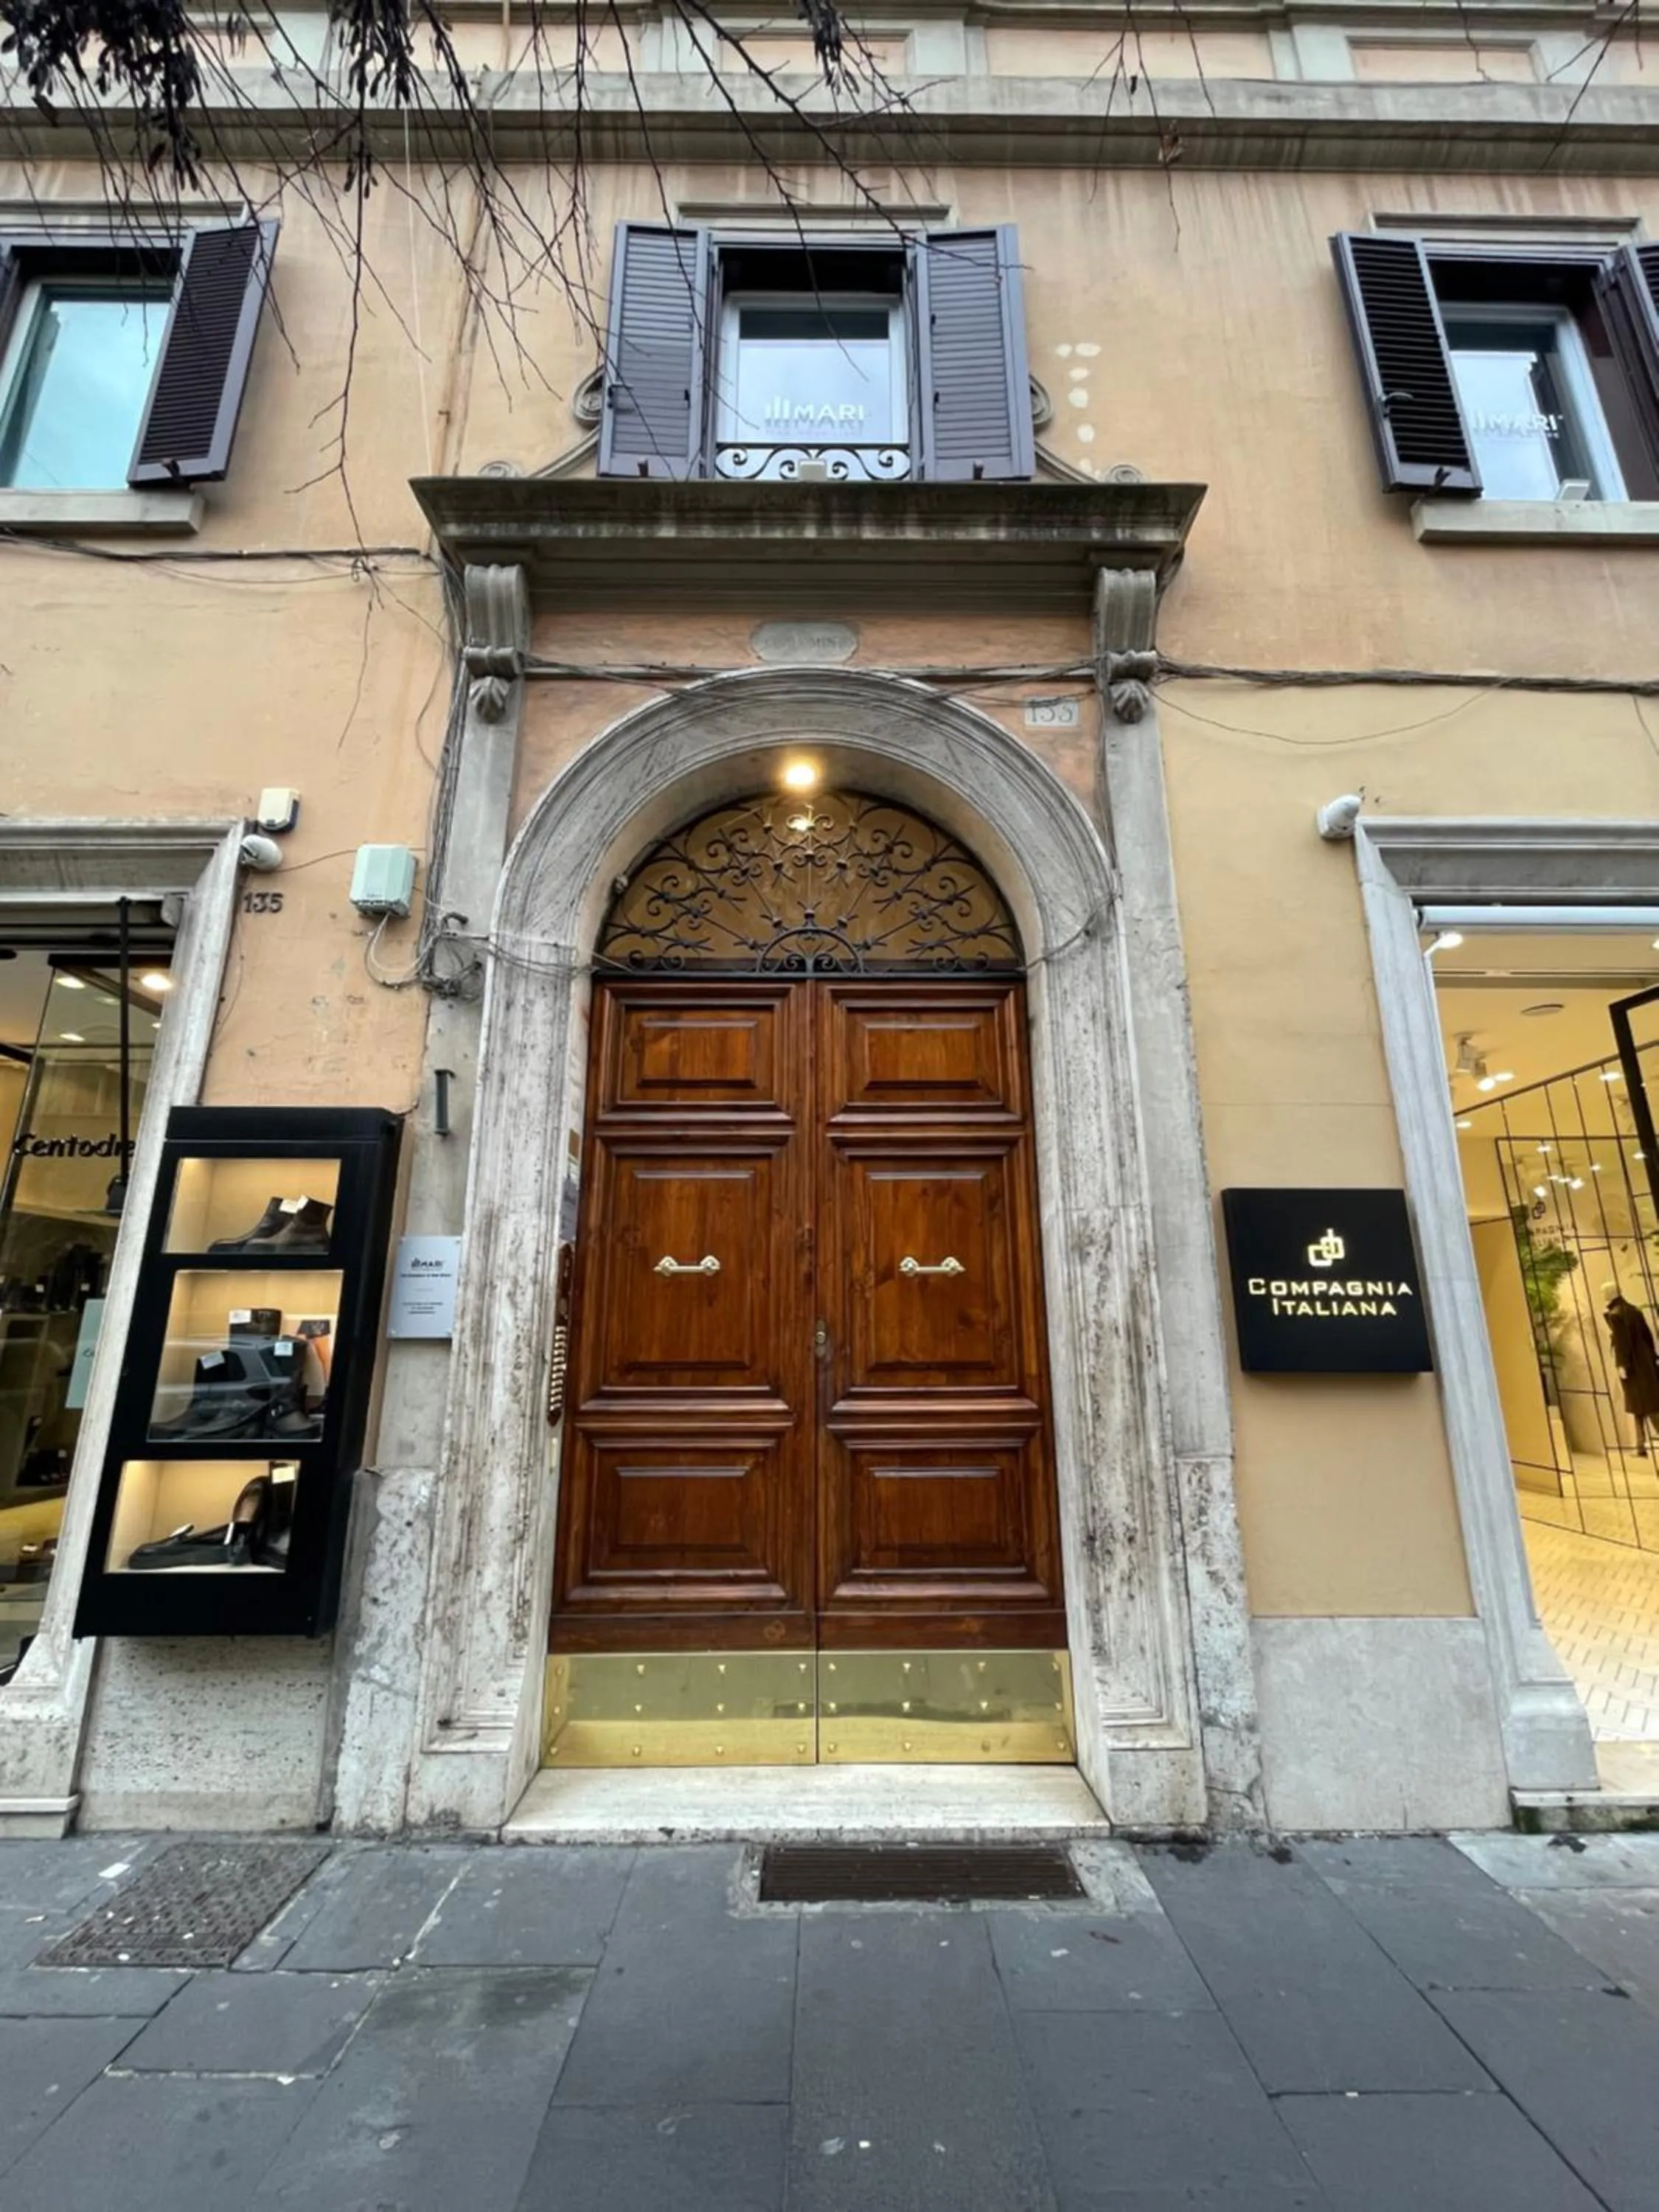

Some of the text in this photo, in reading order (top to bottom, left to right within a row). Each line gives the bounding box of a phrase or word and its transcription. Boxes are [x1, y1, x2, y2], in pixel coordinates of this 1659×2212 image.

[793, 403, 865, 420] MARI
[244, 892, 283, 914] 135
[1248, 1278, 1413, 1296] COMPAGNIA
[1272, 1298, 1397, 1316] ITALIANA
